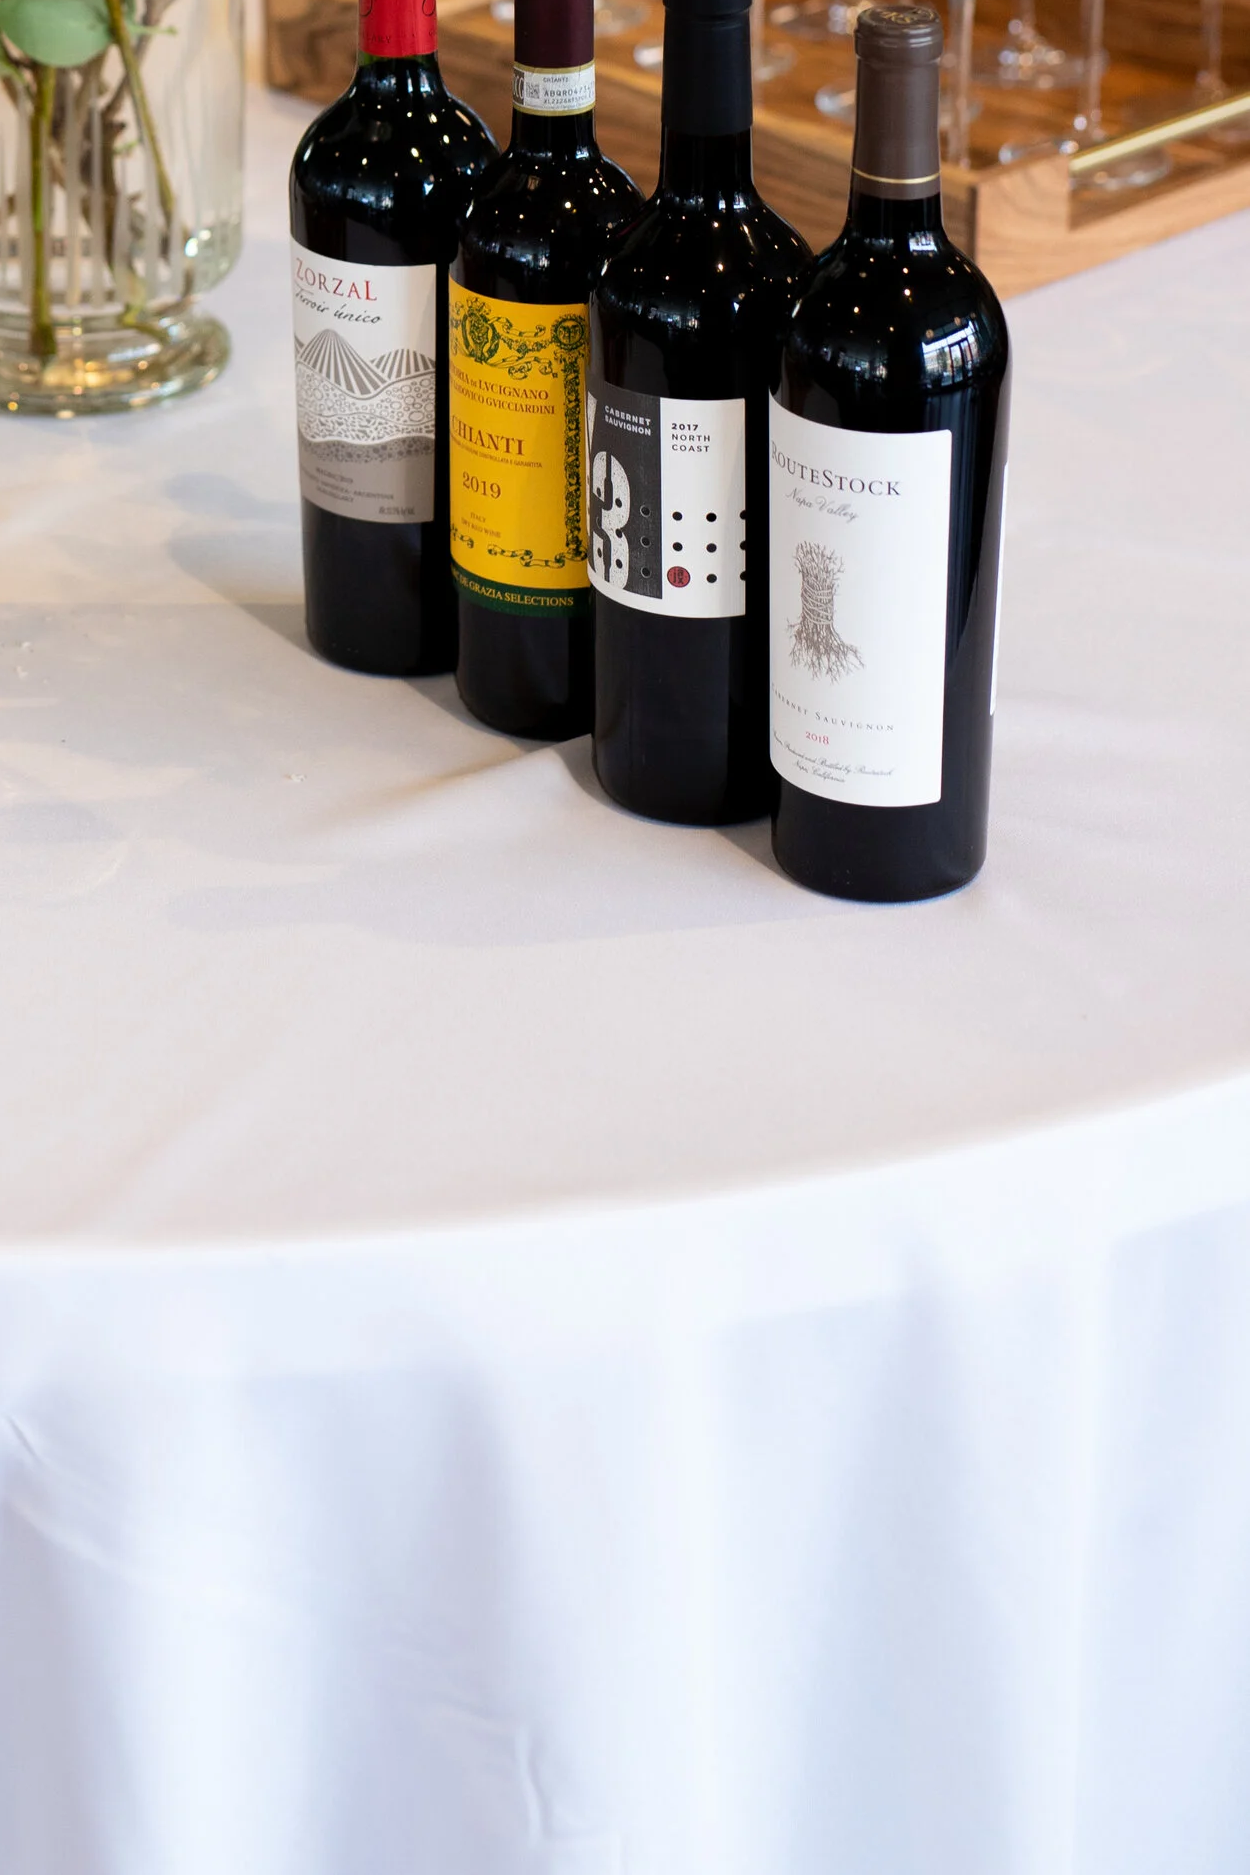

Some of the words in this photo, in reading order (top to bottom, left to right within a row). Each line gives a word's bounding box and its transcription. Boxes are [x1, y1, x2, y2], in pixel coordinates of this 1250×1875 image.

[296, 257, 377, 301] ZORZAL
[333, 303, 381, 324] único
[478, 379, 550, 401] LVCIGNANO
[485, 396, 556, 415] GVICCIARDINI
[604, 405, 652, 426] CABERNET
[452, 414, 525, 456] CHIANTI
[604, 414, 652, 437] SAUVIGNON
[671, 422, 699, 432] 2017
[671, 433, 711, 443] NORTH
[671, 443, 710, 453] COAST
[462, 471, 502, 500] 2019
[785, 487, 813, 510] Napa
[814, 495, 859, 524] Valley
[468, 580, 504, 601] GRAZIA
[504, 592, 574, 607] SELECTIONS
[814, 711, 894, 731] SAUVIGNON
[805, 731, 830, 746] 2018
